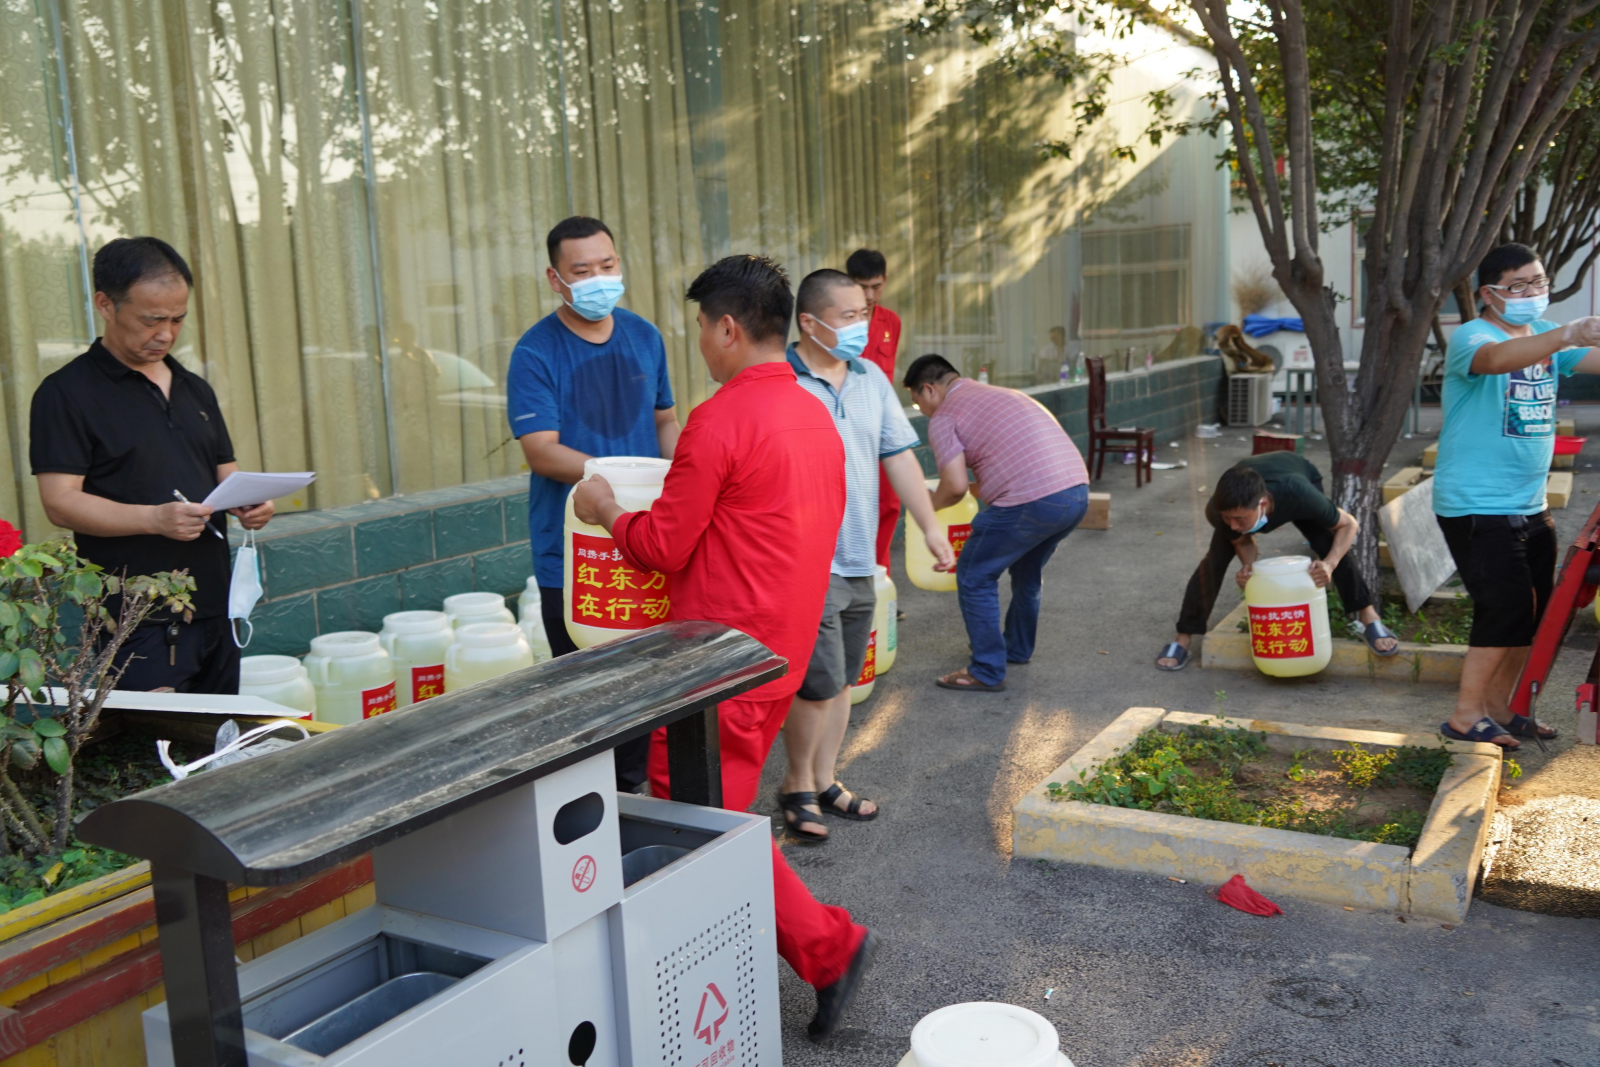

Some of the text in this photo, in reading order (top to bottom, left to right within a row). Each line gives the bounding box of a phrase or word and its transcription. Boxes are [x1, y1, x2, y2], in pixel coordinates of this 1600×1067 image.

[577, 562, 666, 590] 红东方
[577, 593, 670, 621] 在行动
[1252, 621, 1306, 637] 红东方
[1255, 638, 1308, 654] 在行动
[694, 1039, 735, 1067] 可回收物
